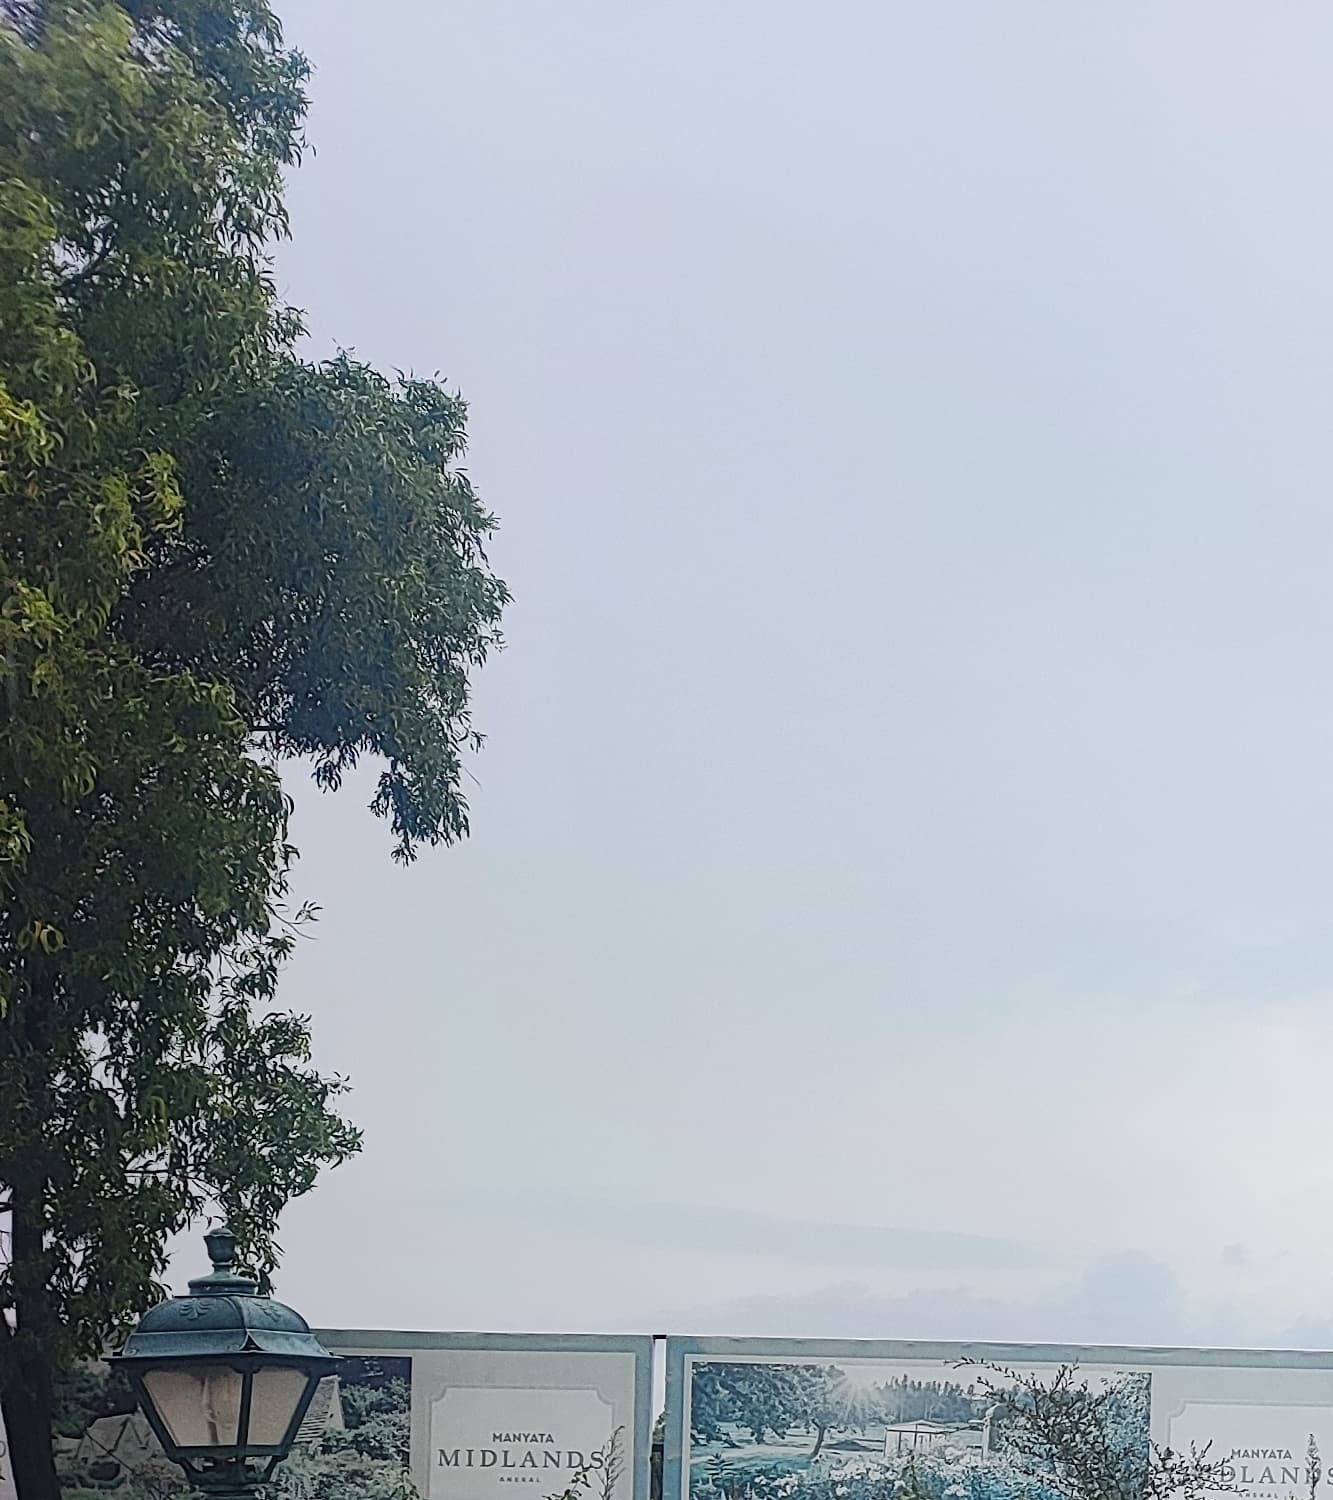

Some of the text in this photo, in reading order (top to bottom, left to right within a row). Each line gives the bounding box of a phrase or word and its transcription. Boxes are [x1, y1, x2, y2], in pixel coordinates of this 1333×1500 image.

[492, 1433, 555, 1444] MANYATA
[437, 1448, 605, 1470] MIDLANDS
[1231, 1449, 1292, 1460] MANYATA
